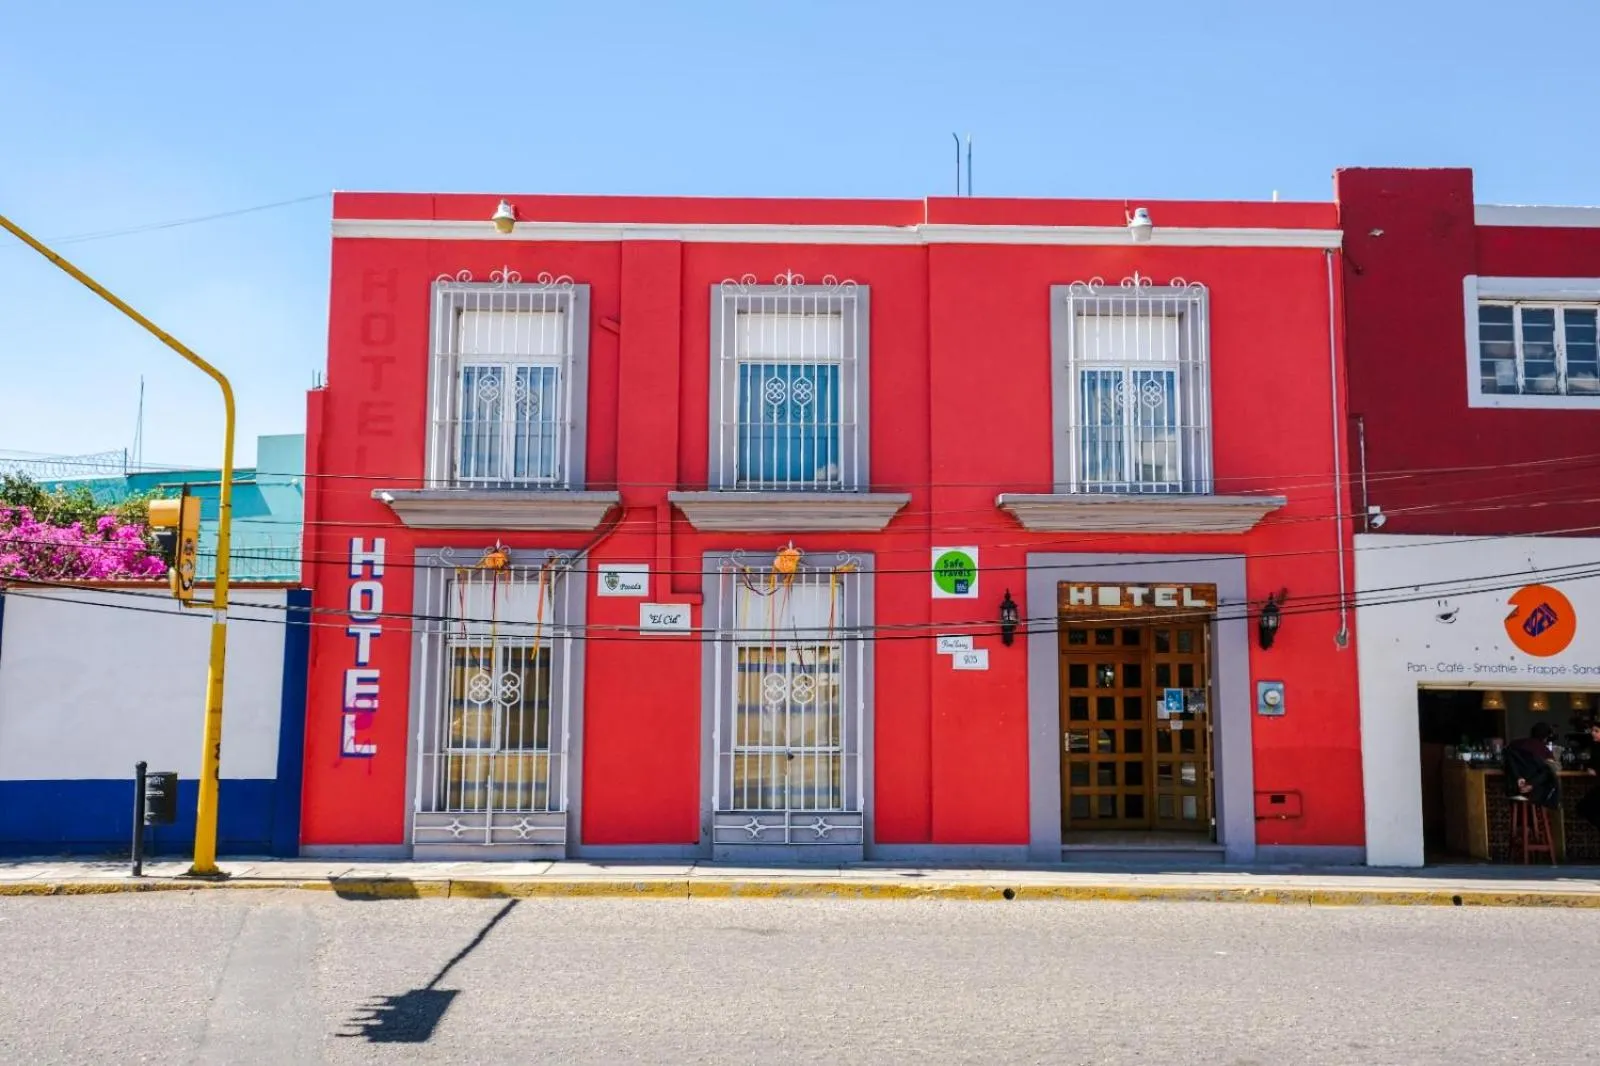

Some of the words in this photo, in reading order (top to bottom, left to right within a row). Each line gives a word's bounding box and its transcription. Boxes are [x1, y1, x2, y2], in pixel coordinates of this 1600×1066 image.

[943, 558, 964, 568] Safe
[939, 568, 972, 577] travels
[341, 537, 386, 757] HOTEL
[1407, 662, 1427, 673] Pan
[1436, 662, 1464, 673] Café
[1473, 662, 1517, 674] Smothie
